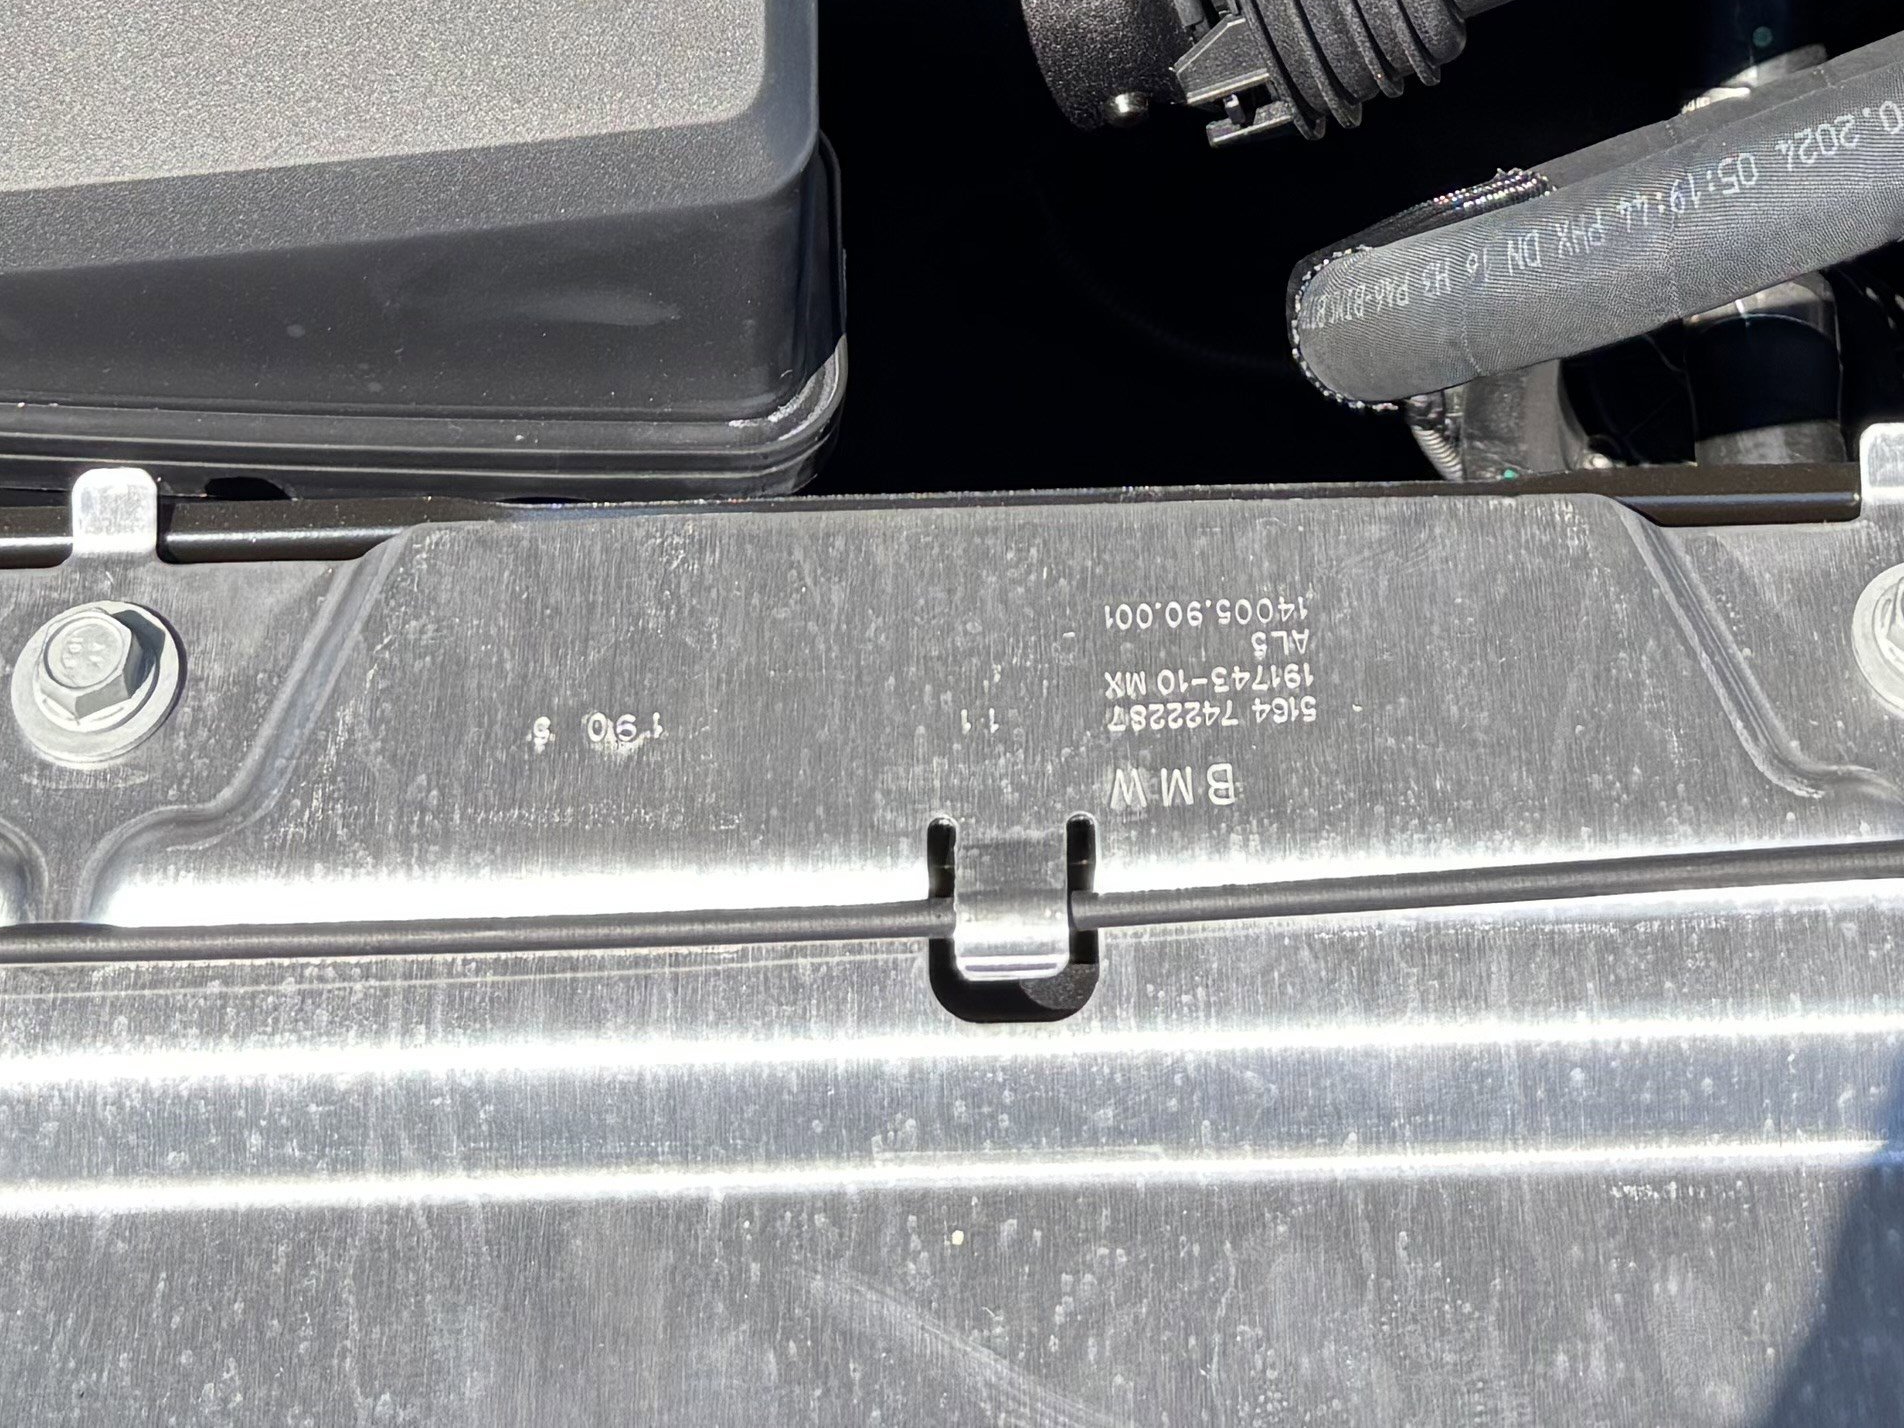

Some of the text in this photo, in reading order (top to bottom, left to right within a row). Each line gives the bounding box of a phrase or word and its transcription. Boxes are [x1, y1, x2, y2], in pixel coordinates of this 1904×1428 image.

[1616, 150, 1760, 234] 05:19:44
[1103, 595, 1309, 630] 14005.90.001
[1103, 661, 1314, 700] 191743-10 MX
[1106, 695, 1317, 734] 5164 7422287
